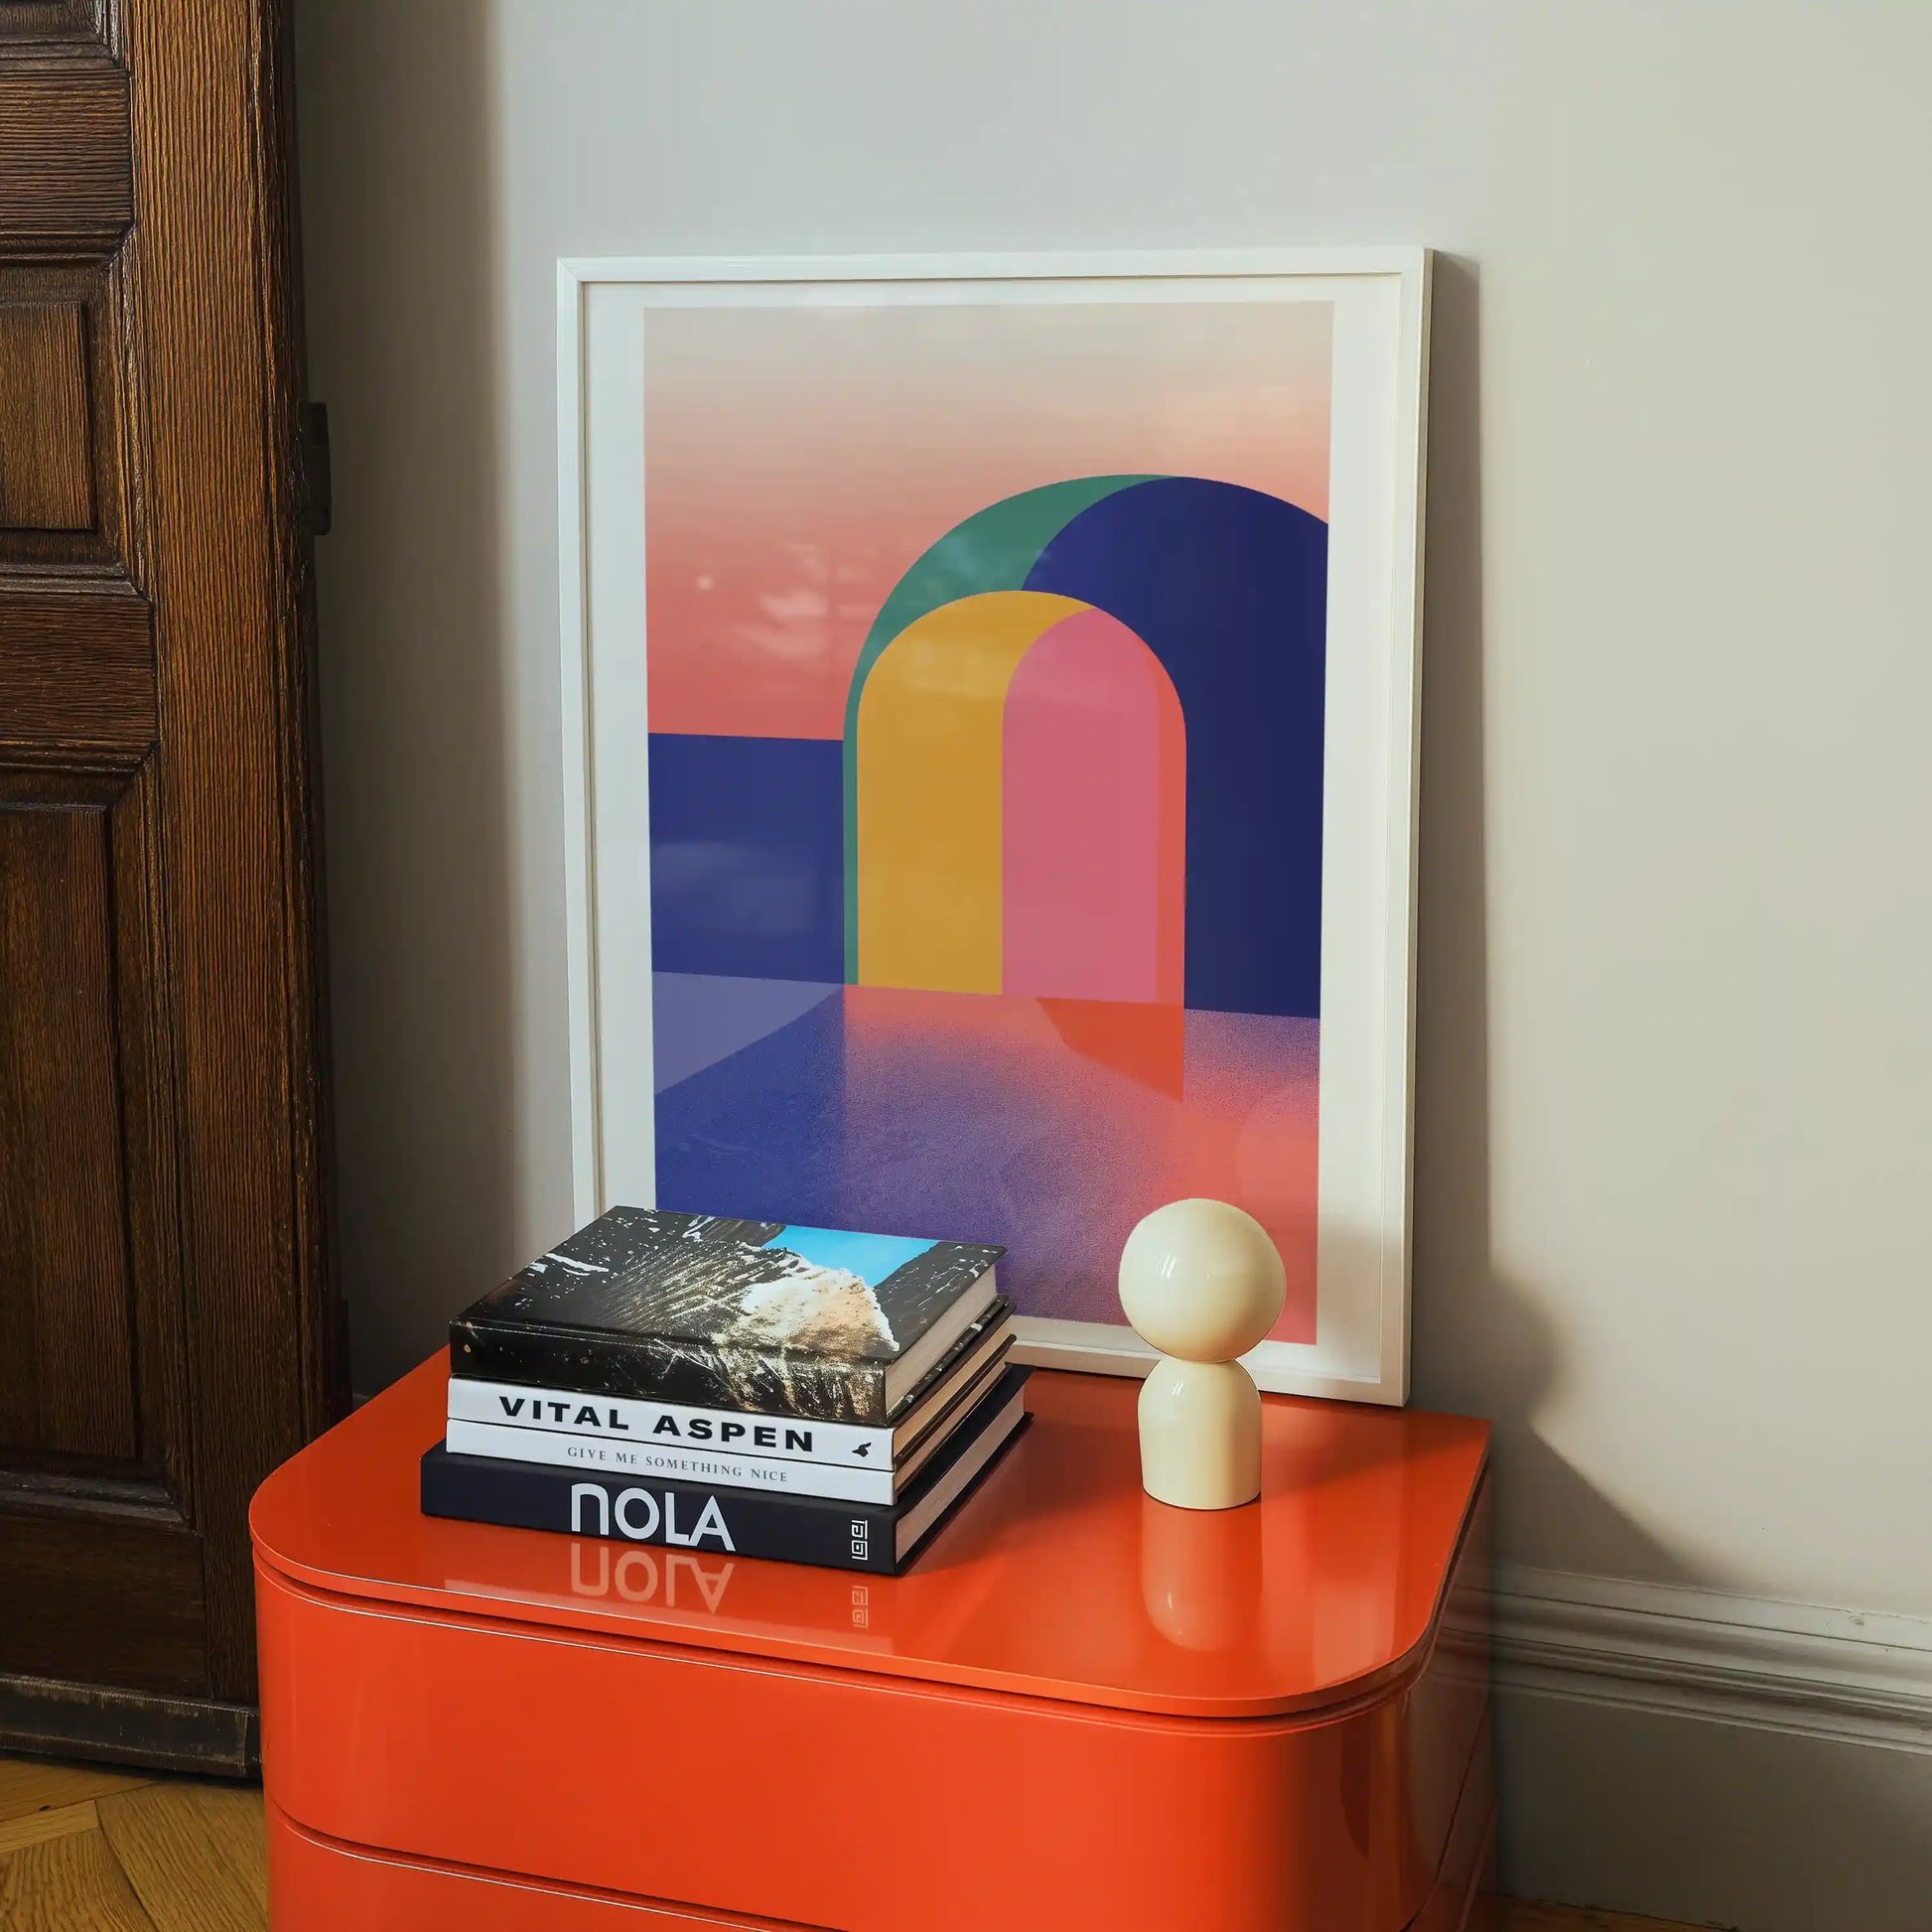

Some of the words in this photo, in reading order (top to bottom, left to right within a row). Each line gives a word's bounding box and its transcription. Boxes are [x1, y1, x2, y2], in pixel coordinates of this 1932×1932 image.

[499, 1396, 628, 1431] VITAL
[652, 1415, 812, 1451] ASPEN
[567, 1447, 607, 1461] GIVE
[616, 1451, 637, 1464] ME
[645, 1456, 743, 1477] SOMETHING
[751, 1468, 787, 1482] NICE
[571, 1482, 736, 1552] NOLA
